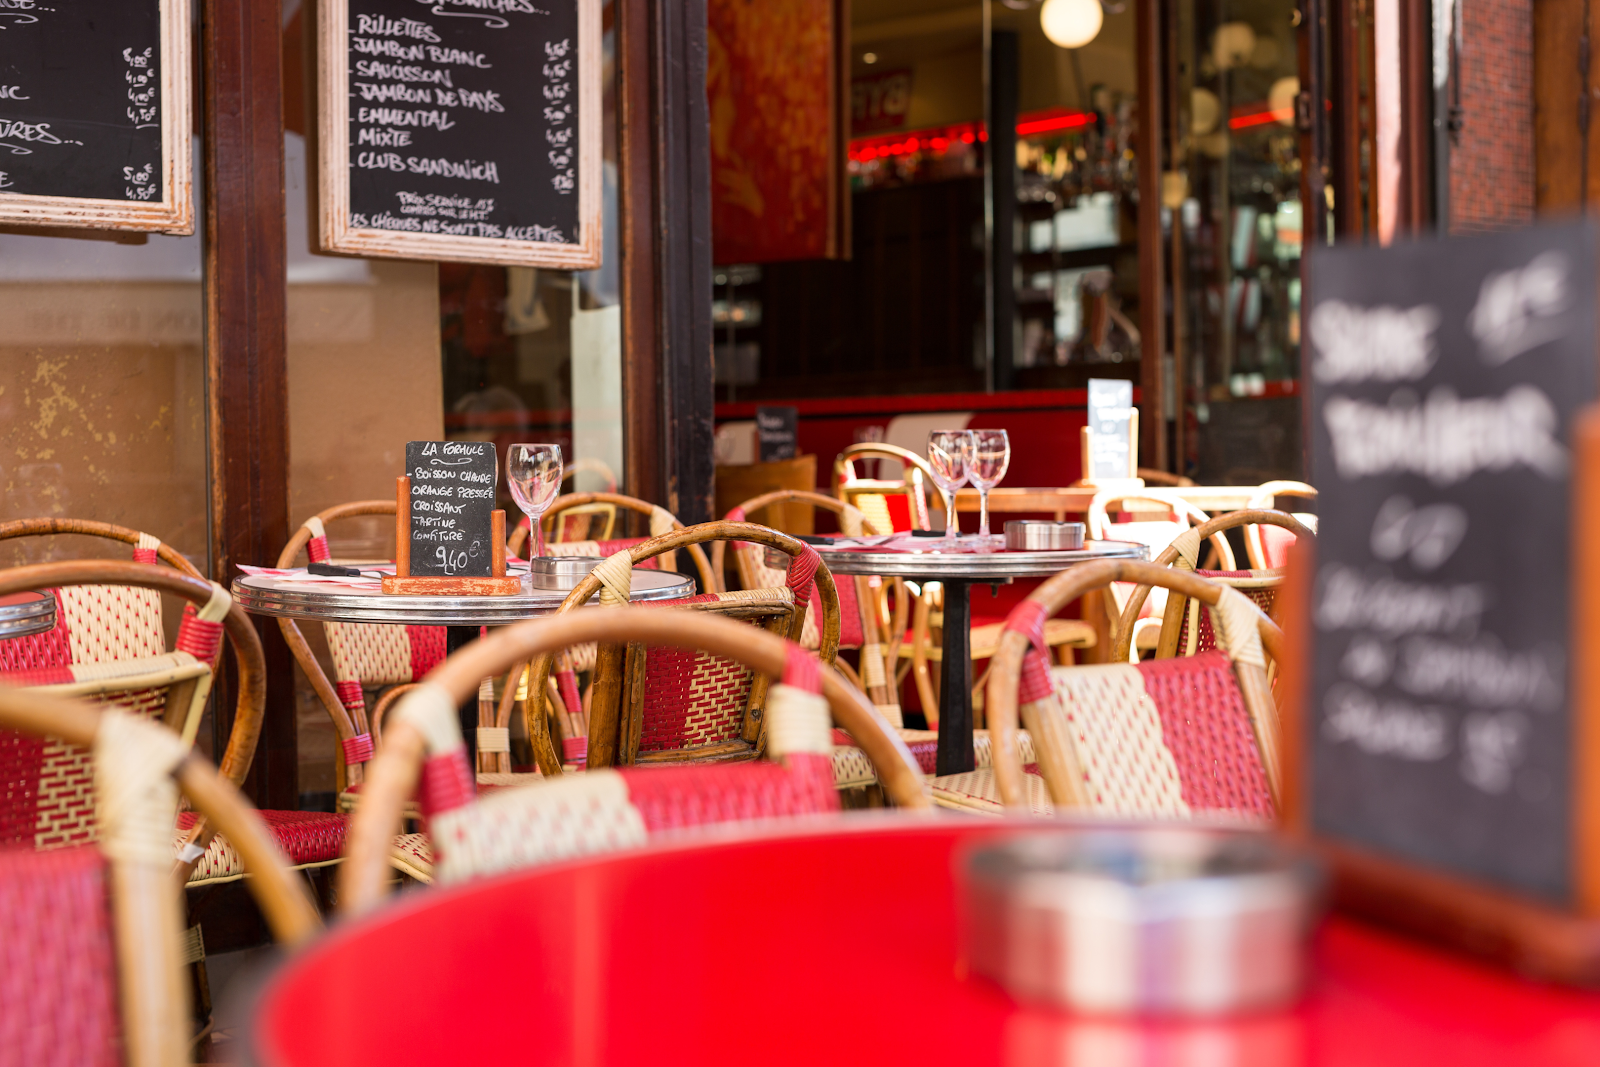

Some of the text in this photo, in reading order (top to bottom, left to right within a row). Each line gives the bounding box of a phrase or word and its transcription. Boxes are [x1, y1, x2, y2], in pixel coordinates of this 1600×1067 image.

[352, 36, 492, 68] JAMBON BLANC
[354, 82, 505, 113] JAMBON DE PAYS
[358, 107, 456, 132] EMMENTAL
[357, 151, 407, 172] CLUB
[422, 218, 440, 234] NE
[439, 220, 478, 236] SONT
[476, 221, 503, 239] PAS
[421, 441, 484, 456] LA FORMULE
[460, 471, 491, 484] CHAUDE
[412, 485, 454, 497] ORANGE
[412, 516, 456, 529] TARTINE
